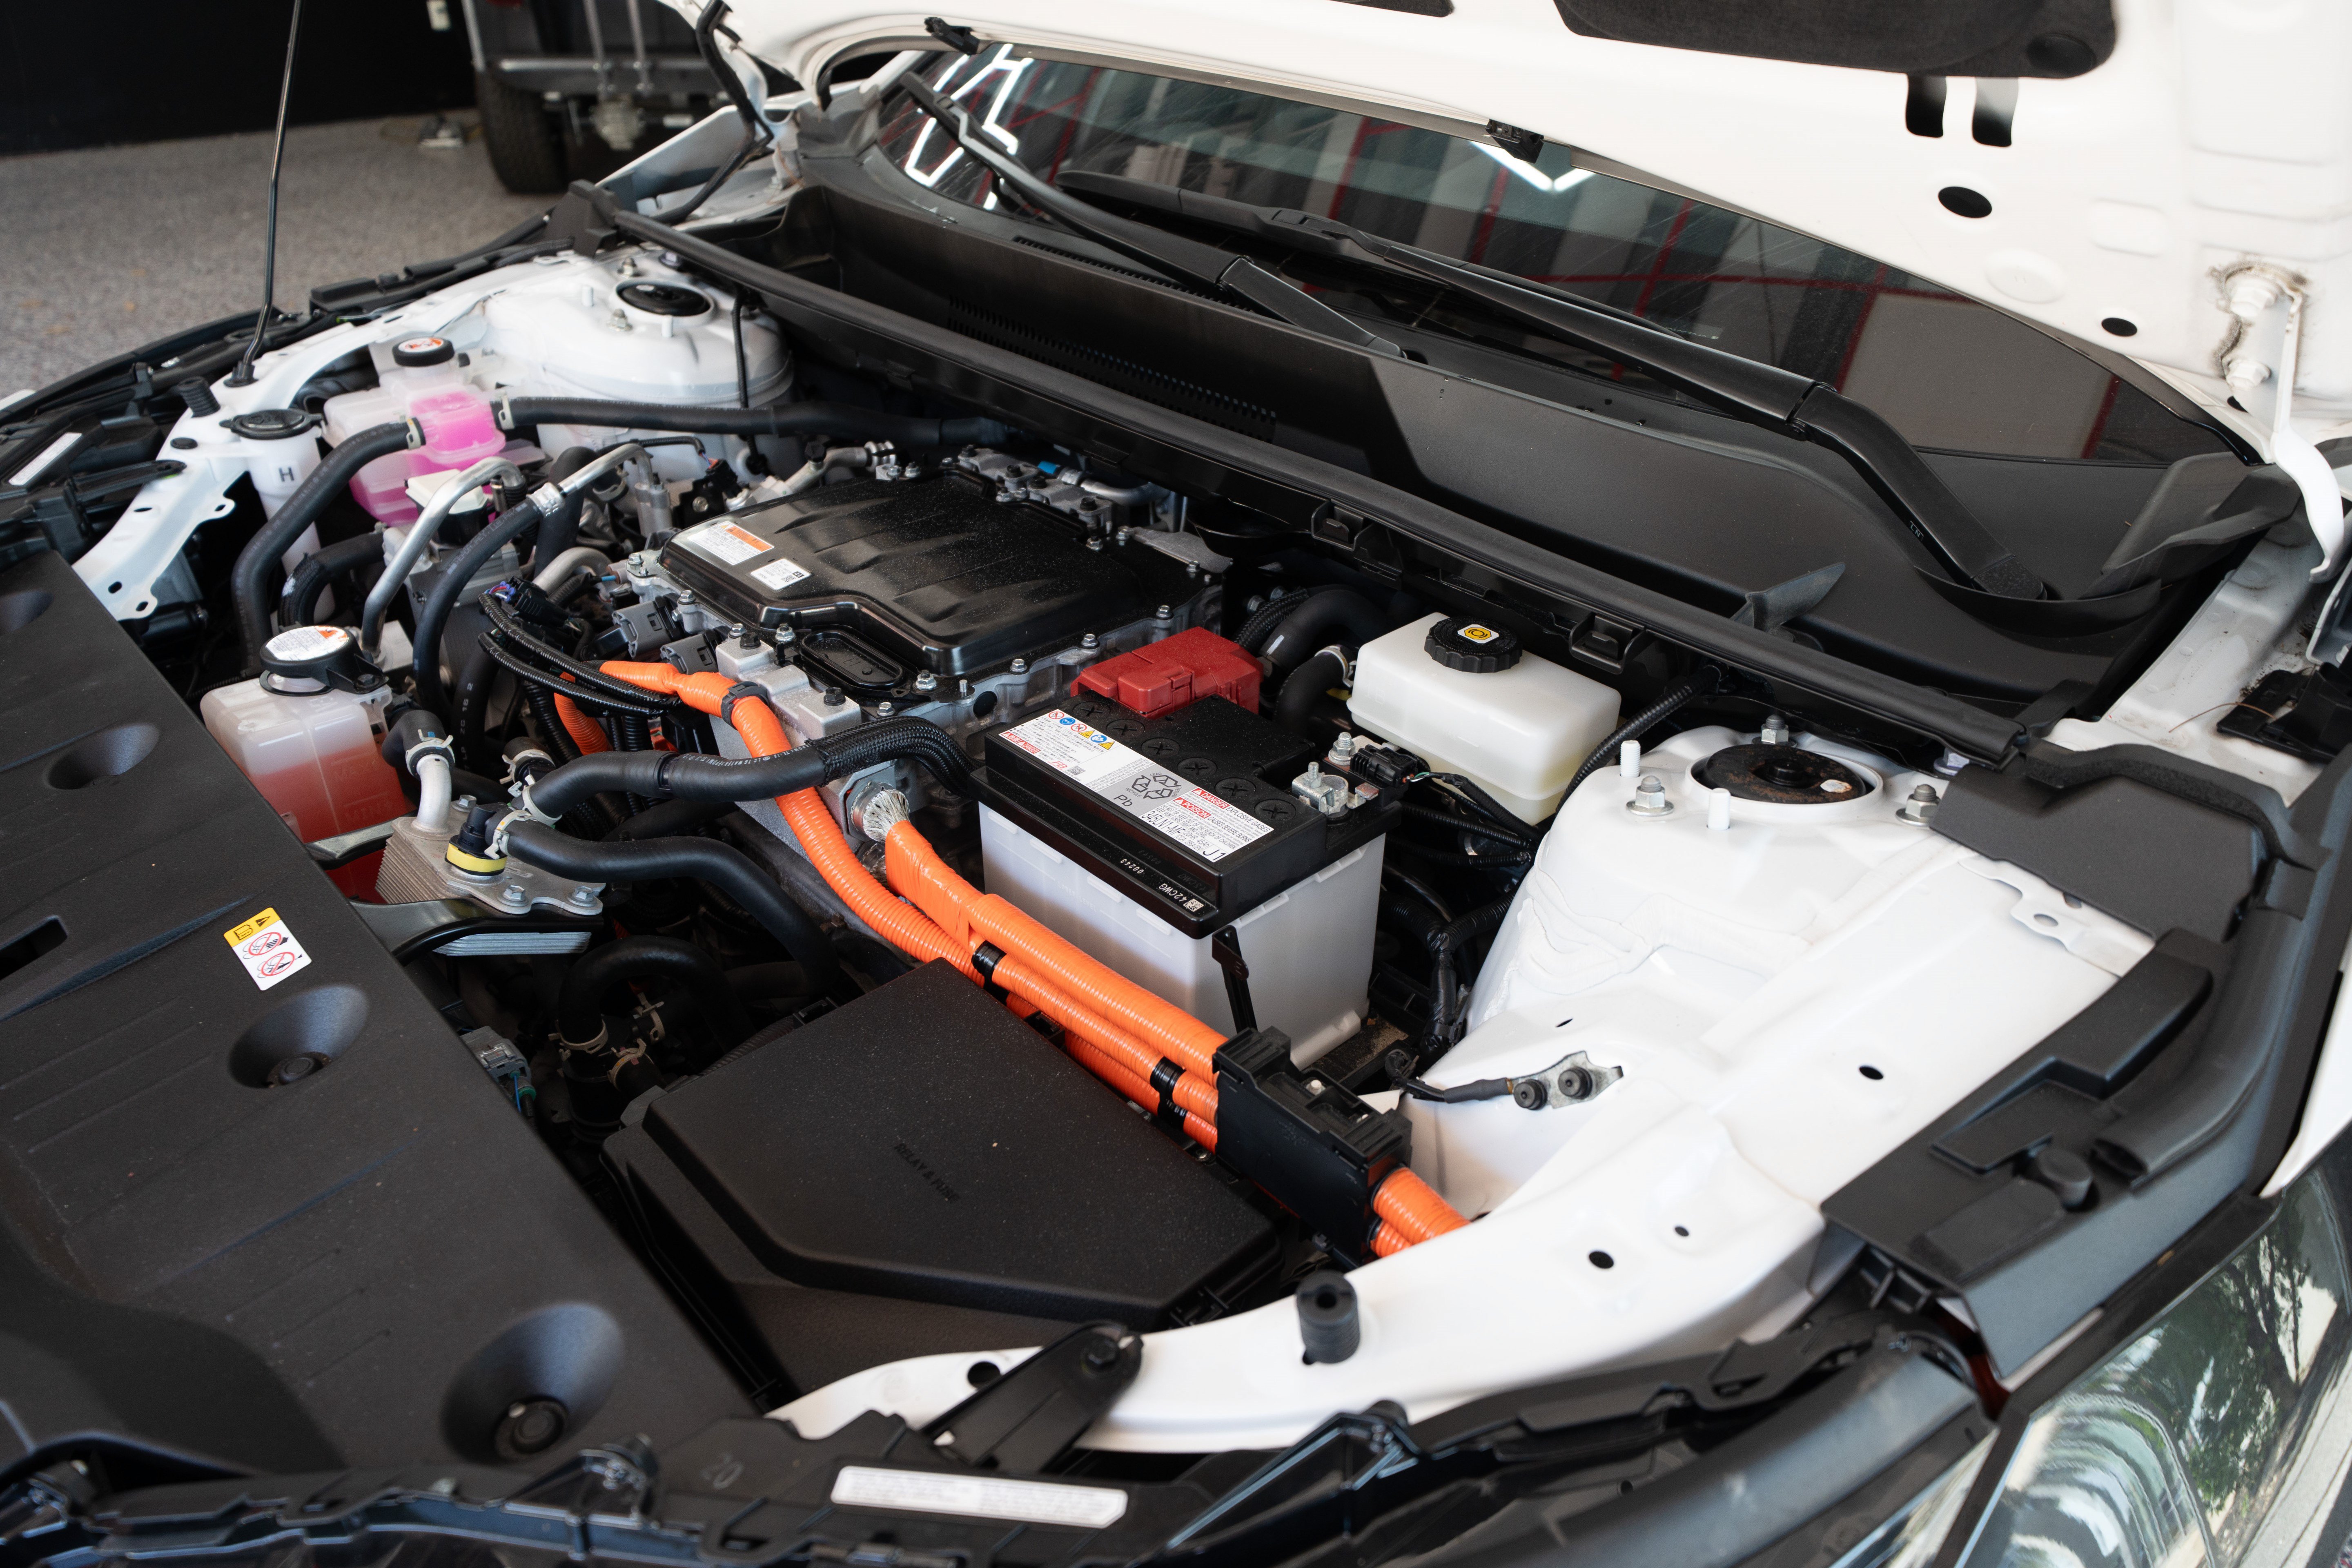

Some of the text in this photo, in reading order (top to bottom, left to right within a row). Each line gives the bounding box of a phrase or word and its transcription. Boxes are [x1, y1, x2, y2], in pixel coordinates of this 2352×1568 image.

[278, 466, 295, 483] H
[1910, 524, 1920, 537] LN
[462, 698, 469, 712] 16
[467, 682, 474, 691] 2
[1020, 743, 1040, 754] DANGER
[1113, 794, 1133, 807] Pb
[1125, 787, 1142, 798] RECYCLE
[1172, 787, 1181, 798] RETURN
[1200, 792, 1271, 833] DANGER EXPLOSIVE GASES
[1140, 810, 1186, 837] 345LN1-MF
[1180, 802, 1252, 843] POISON CAUSES SEVERE BURNS
[1182, 831, 1211, 848] 20HR 45Ah
[1202, 829, 1217, 837] REACH
[1120, 858, 1187, 902] 42CWG 00243
